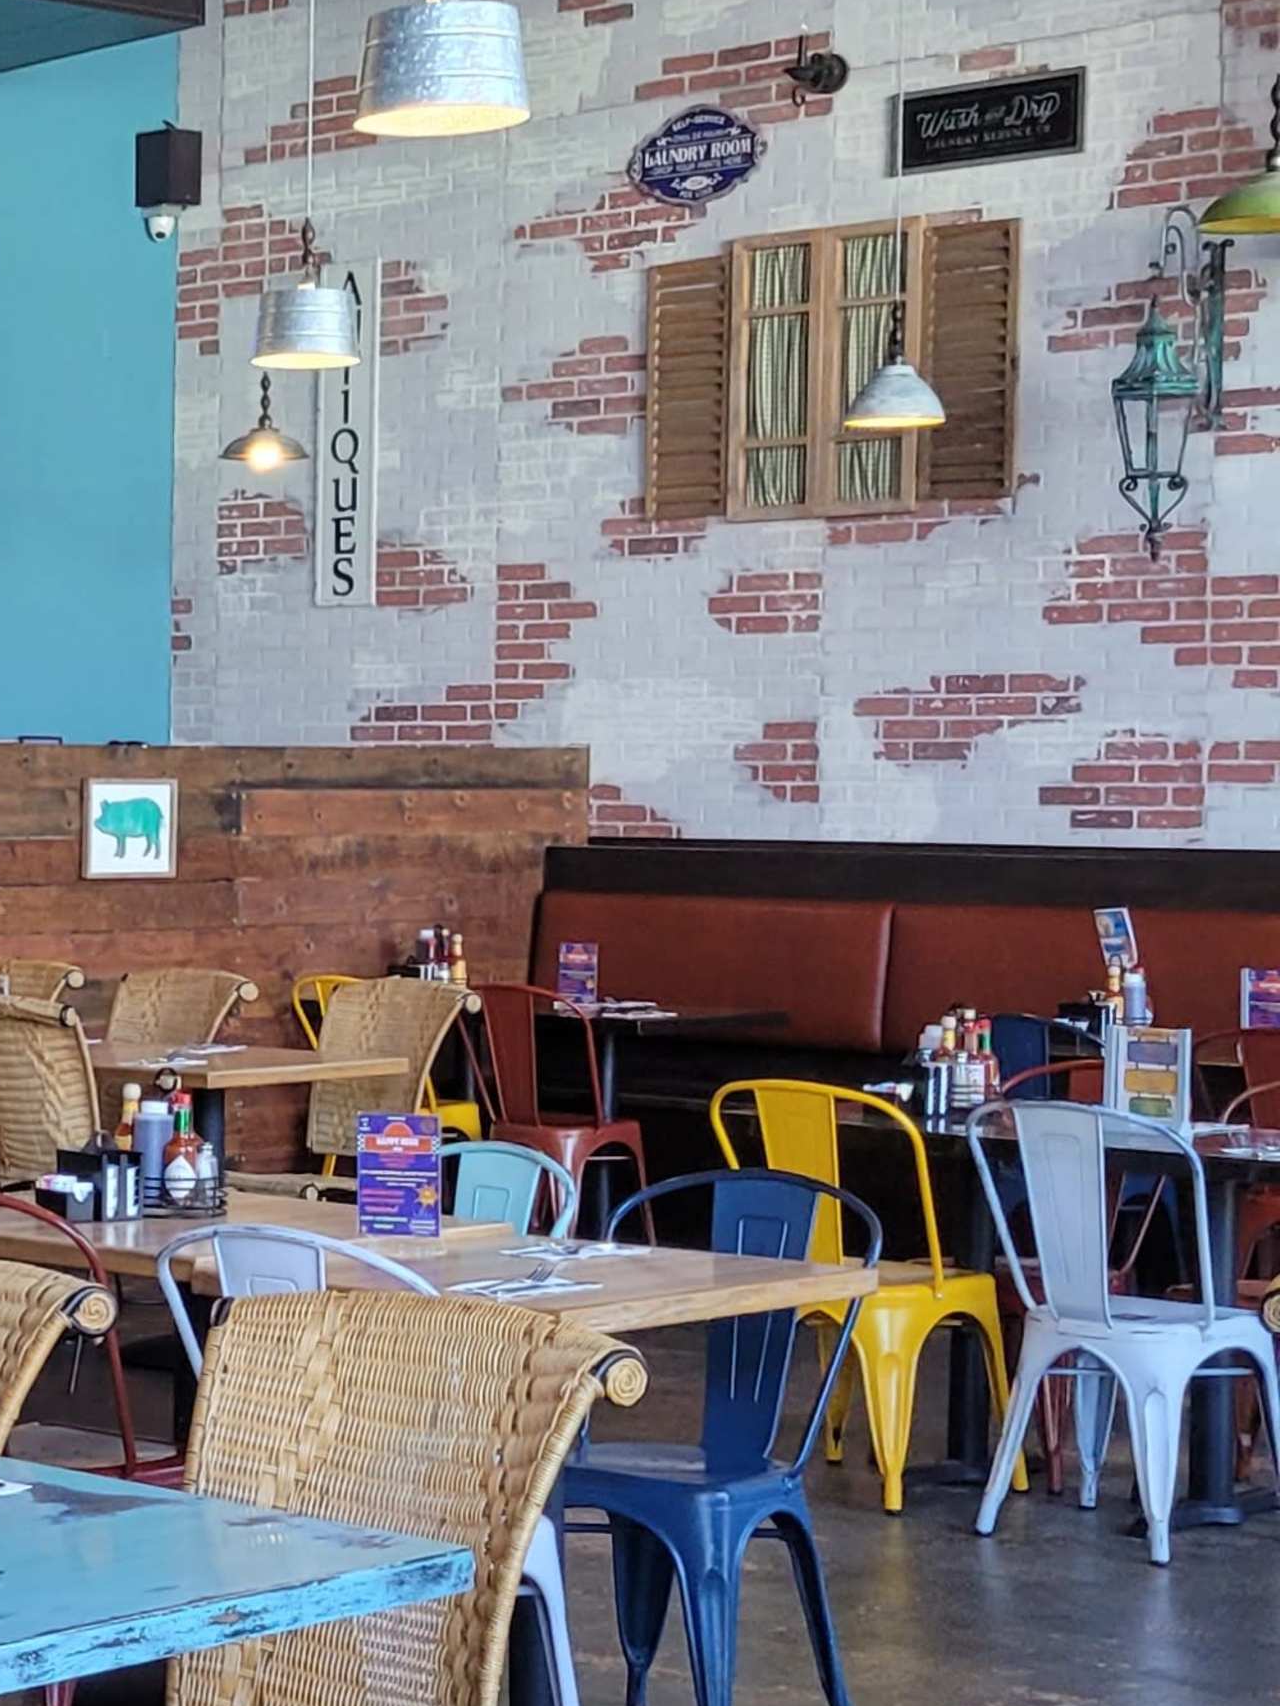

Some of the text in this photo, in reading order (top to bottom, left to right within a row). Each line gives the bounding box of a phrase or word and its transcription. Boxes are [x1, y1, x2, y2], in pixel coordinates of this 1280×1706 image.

[916, 102, 981, 139] Wash
[1004, 92, 1061, 128] Dry
[644, 137, 752, 169] LAUNDRY ROOM
